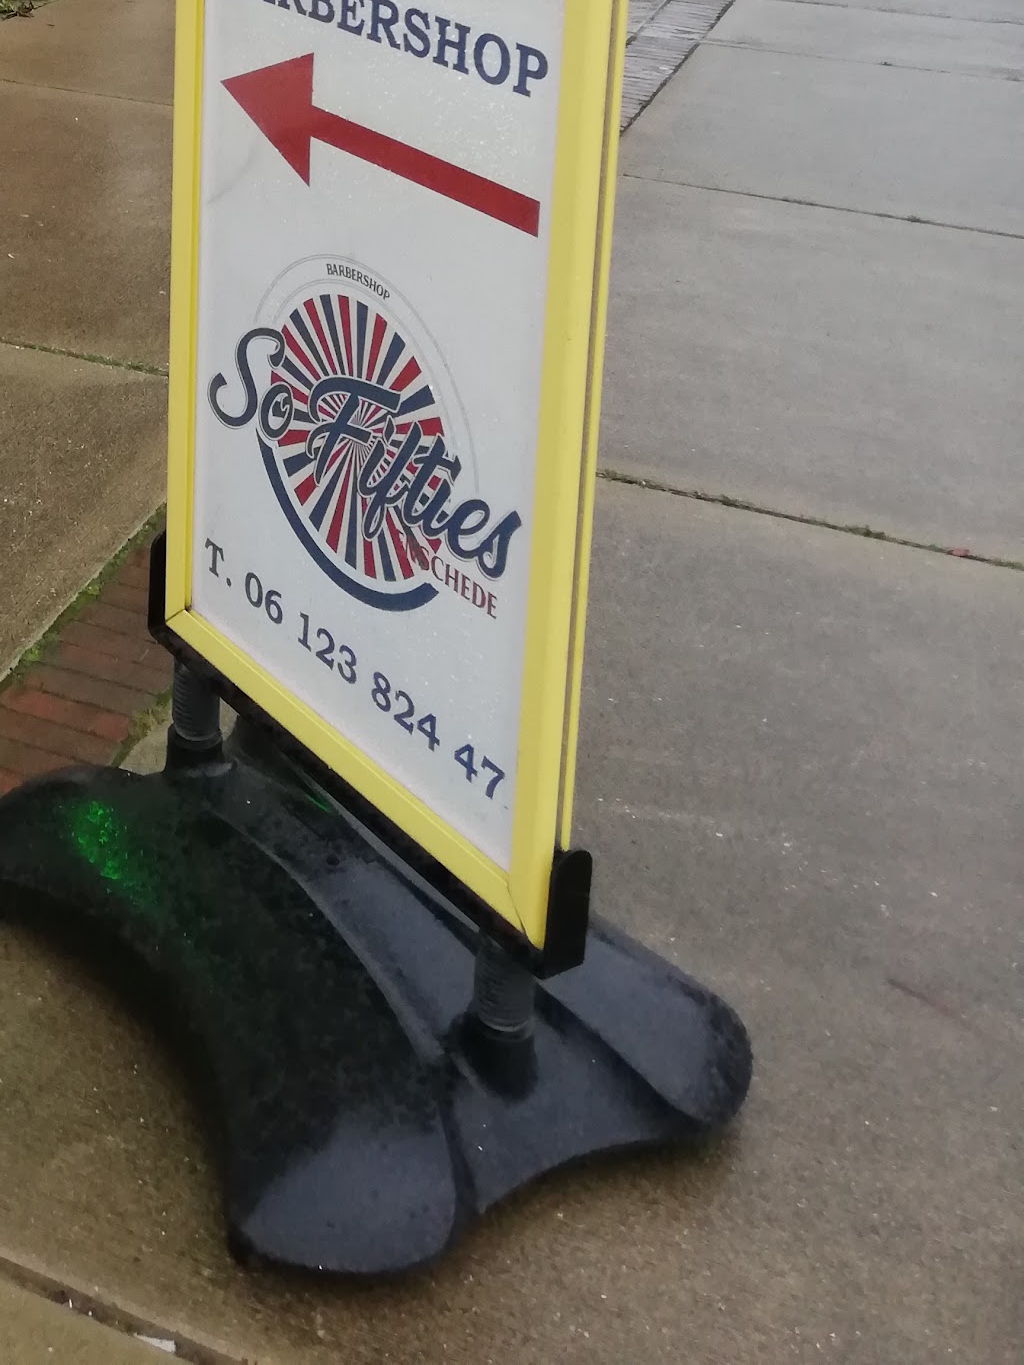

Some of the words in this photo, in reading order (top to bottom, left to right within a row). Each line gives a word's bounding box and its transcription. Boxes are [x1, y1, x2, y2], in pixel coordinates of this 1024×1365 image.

[326, 263, 391, 301] BARBERSHOP
[208, 327, 295, 440] So
[306, 375, 523, 579] Fifties
[205, 538, 233, 587] T.
[244, 572, 283, 624] 06
[297, 612, 358, 684] 123
[371, 671, 440, 751] 824
[454, 743, 506, 800] 47
